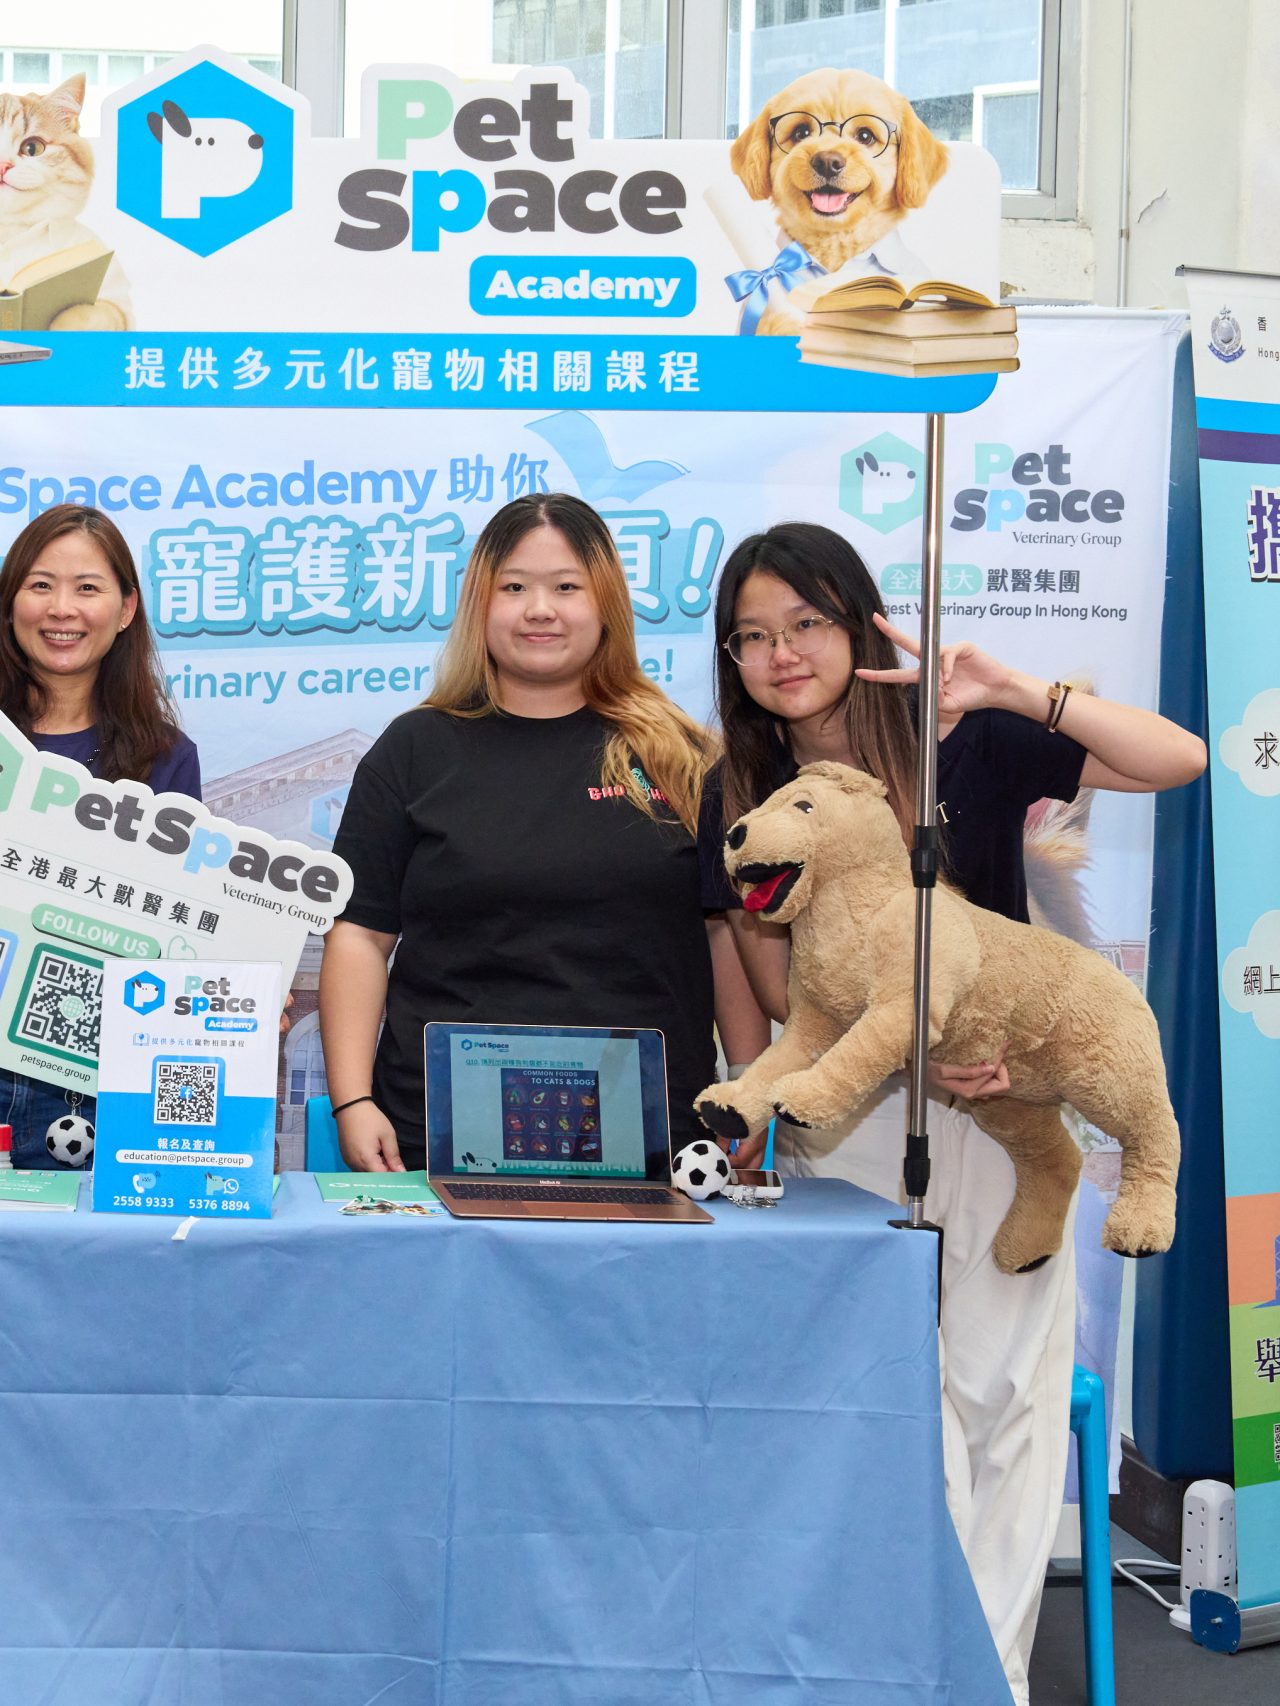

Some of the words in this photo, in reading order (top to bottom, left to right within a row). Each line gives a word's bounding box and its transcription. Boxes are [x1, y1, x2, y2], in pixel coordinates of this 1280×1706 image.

[377, 79, 576, 163] Pet
[334, 168, 687, 252] Space
[485, 269, 682, 308] Academy
[124, 346, 701, 394] 提供多元化寵物相關課程
[1258, 347, 1280, 362] Hong
[974, 443, 1071, 486] Pet
[171, 460, 438, 515] Academy
[449, 452, 549, 504] 助你
[950, 488, 1125, 532] Space
[1013, 531, 1078, 547] Veterinary
[1081, 532, 1122, 547] Group
[987, 568, 1081, 593] 獸醫集團
[914, 603, 987, 619] Verinary
[989, 604, 1032, 619] Group
[1035, 605, 1045, 617] In
[1051, 604, 1088, 620] Hong
[1091, 605, 1128, 621] Kong
[297, 658, 430, 693] career
[0, 847, 220, 935] 全港最大獸醫集團
[222, 882, 288, 915] Veterinary
[288, 904, 327, 928] Group
[40, 911, 122, 948] FOLLOW
[123, 937, 150, 958] US
[184, 975, 231, 995] Pet
[174, 996, 257, 1016] Space
[207, 1020, 255, 1031] Academy
[21, 1052, 91, 1084] petspace.group
[123, 1152, 245, 1166] education@petspace.group
[157, 1138, 216, 1152] 報名及查詢
[113, 1196, 142, 1207] 2558
[145, 1196, 174, 1208] 9333
[188, 1199, 218, 1210] 5376
[221, 1200, 250, 1211] 8894
